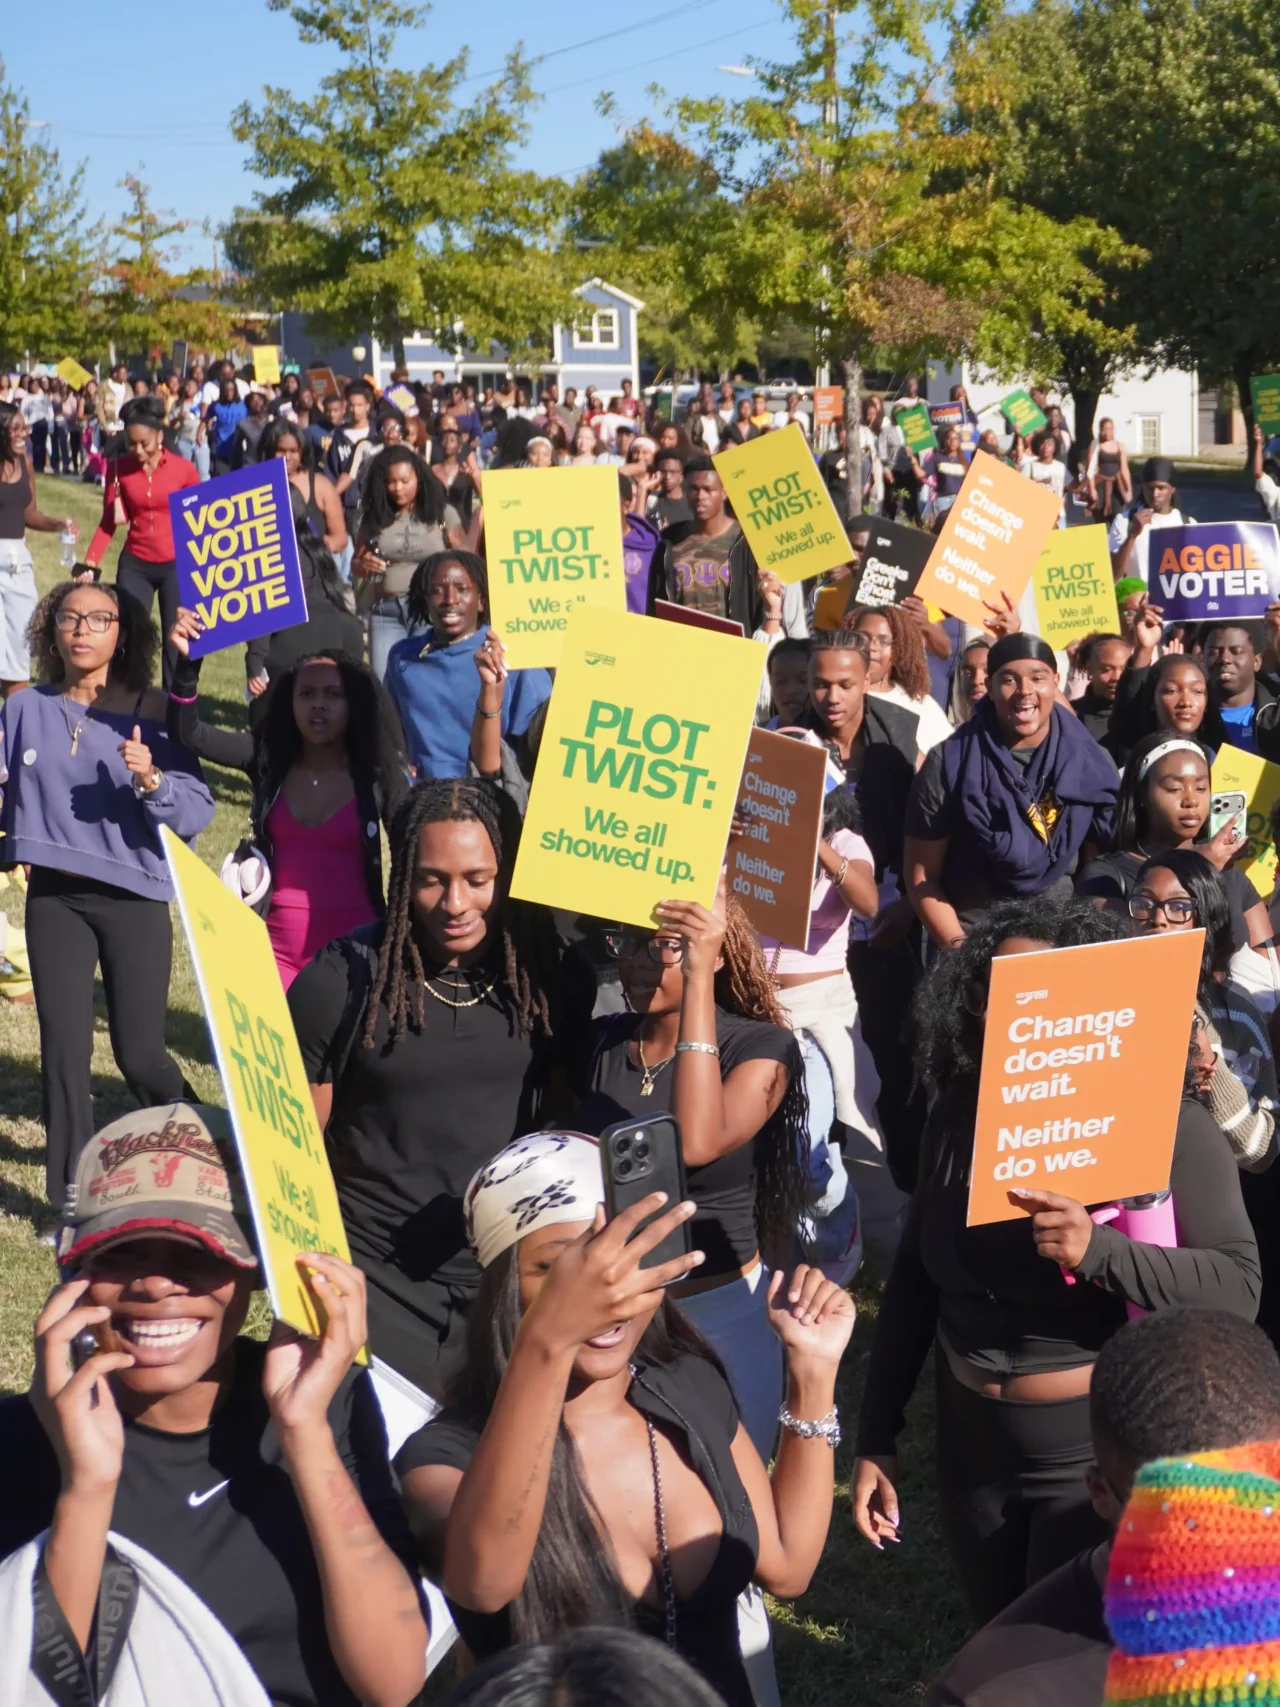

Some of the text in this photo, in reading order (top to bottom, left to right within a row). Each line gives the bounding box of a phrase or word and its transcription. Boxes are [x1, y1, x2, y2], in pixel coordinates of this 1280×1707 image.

[747, 471, 801, 508] PLOT
[183, 484, 277, 536] VOTE
[746, 489, 822, 530] TWIST:
[969, 489, 1023, 529] Change
[187, 513, 280, 566] VOTE
[513, 525, 594, 555] PLOT
[766, 531, 835, 565] showed up.
[775, 522, 814, 546] We all
[954, 523, 986, 551] wait.
[191, 544, 285, 598] VOTE
[499, 554, 610, 584] TWIST:
[866, 557, 909, 581] Greeks
[941, 547, 996, 585] Neither
[1046, 562, 1095, 583] PLOT
[1159, 543, 1262, 574] AGGIE
[859, 579, 896, 600] Ghost
[862, 568, 896, 588] Don't
[934, 565, 980, 599] do we.
[1040, 579, 1106, 600] TWIST:
[1159, 569, 1269, 599] VOTER
[195, 576, 290, 629] VOTE
[529, 598, 560, 614] We
[1059, 605, 1093, 618] We all
[505, 617, 568, 634] showe
[1046, 615, 1110, 632] showed up.
[584, 699, 710, 761] PLOT
[559, 736, 717, 809] TWIST:
[744, 771, 797, 806] Change
[584, 806, 668, 847] We all
[540, 828, 696, 884] showed up.
[735, 850, 785, 885] Neither
[733, 875, 777, 905] do we.
[224, 988, 292, 1089] PLOT
[1008, 1007, 1136, 1043] Change
[1004, 1034, 1122, 1074] doesn't
[229, 1046, 320, 1164] TWIST:
[1001, 1073, 1077, 1105] wait.
[997, 1115, 1115, 1152] Neither
[993, 1148, 1098, 1181] do we.
[272, 1160, 302, 1212] We
[302, 1185, 320, 1224] all
